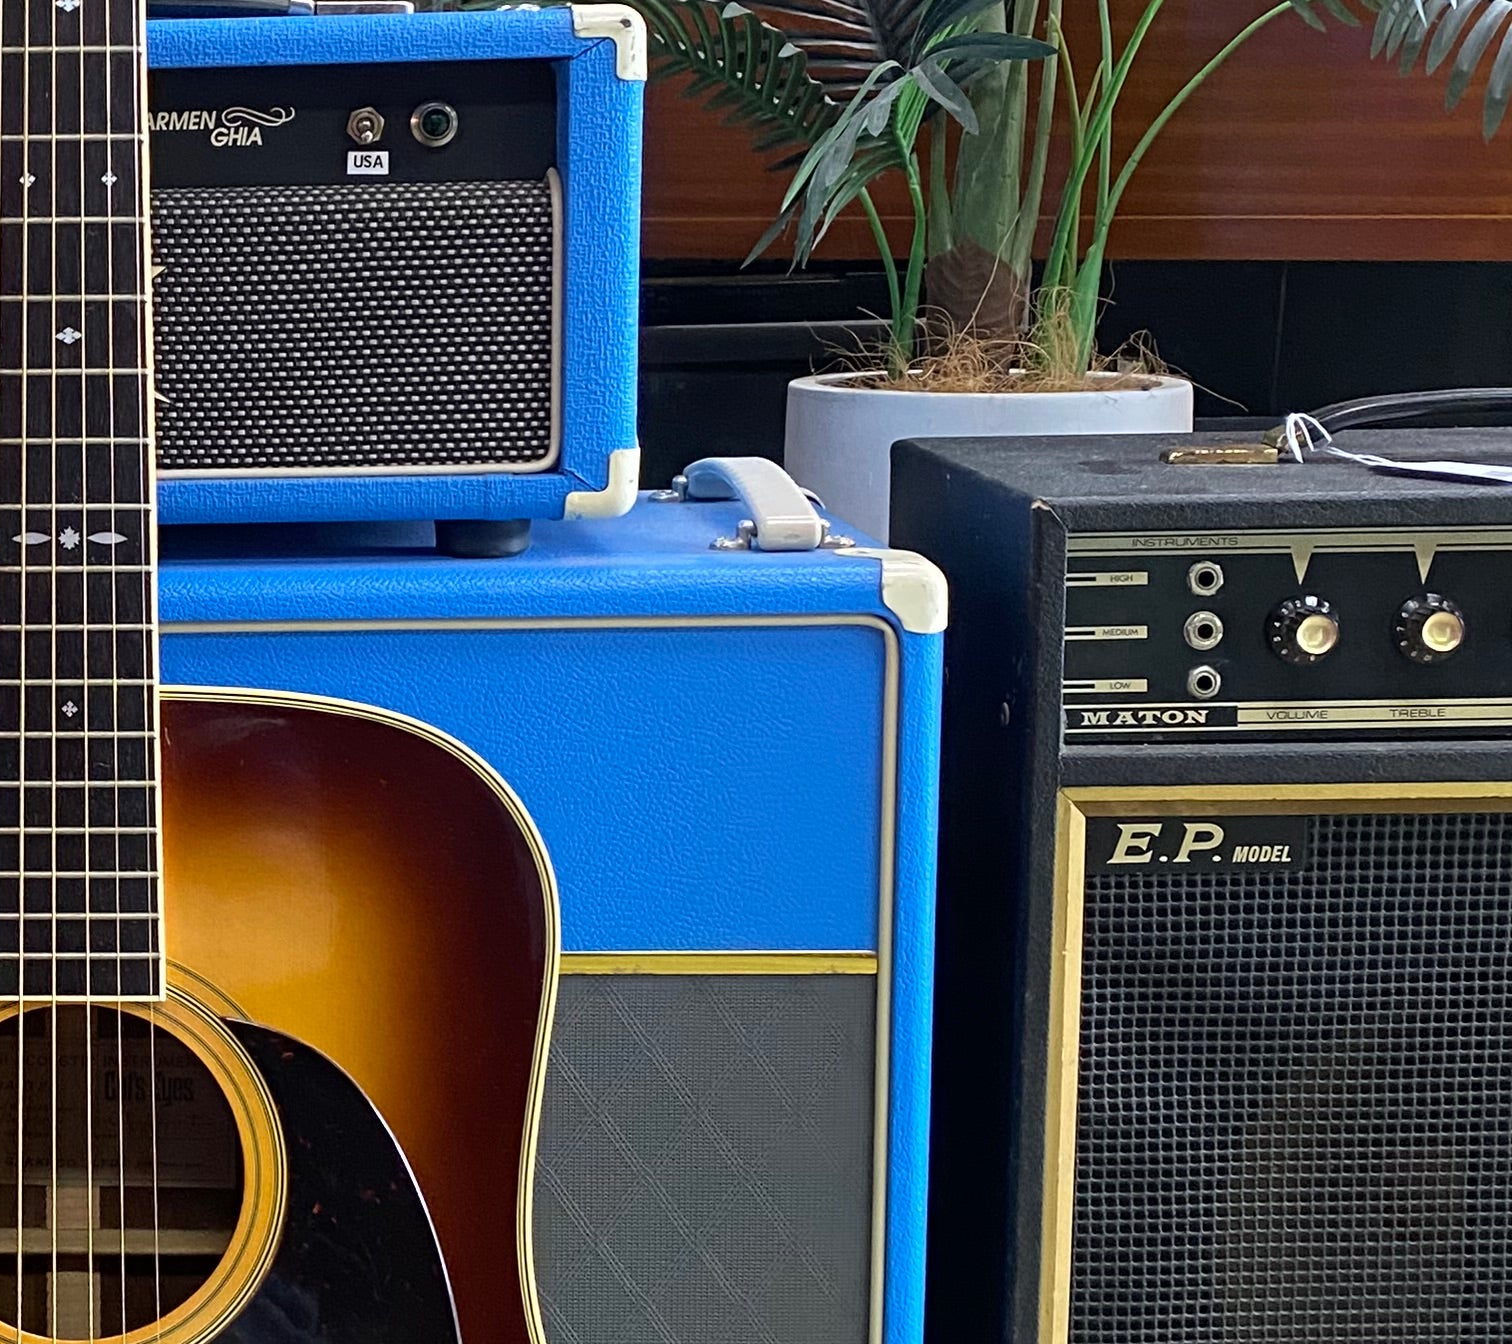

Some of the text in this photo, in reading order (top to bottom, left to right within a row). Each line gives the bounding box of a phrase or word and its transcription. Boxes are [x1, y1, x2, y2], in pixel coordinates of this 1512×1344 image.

[148, 111, 217, 131] ARMEN
[210, 127, 263, 146] GHIA
[353, 154, 384, 168] USA
[1131, 537, 1239, 547] INSTRUMENTS
[1110, 574, 1134, 583] HIGH
[1102, 628, 1139, 637] MEDIUM
[1110, 680, 1131, 690] LOW
[1080, 709, 1209, 726] MATON
[1266, 710, 1329, 720] VOLUME
[1389, 708, 1446, 718] TREBLE
[1106, 822, 1292, 864] E.P. MODEL
